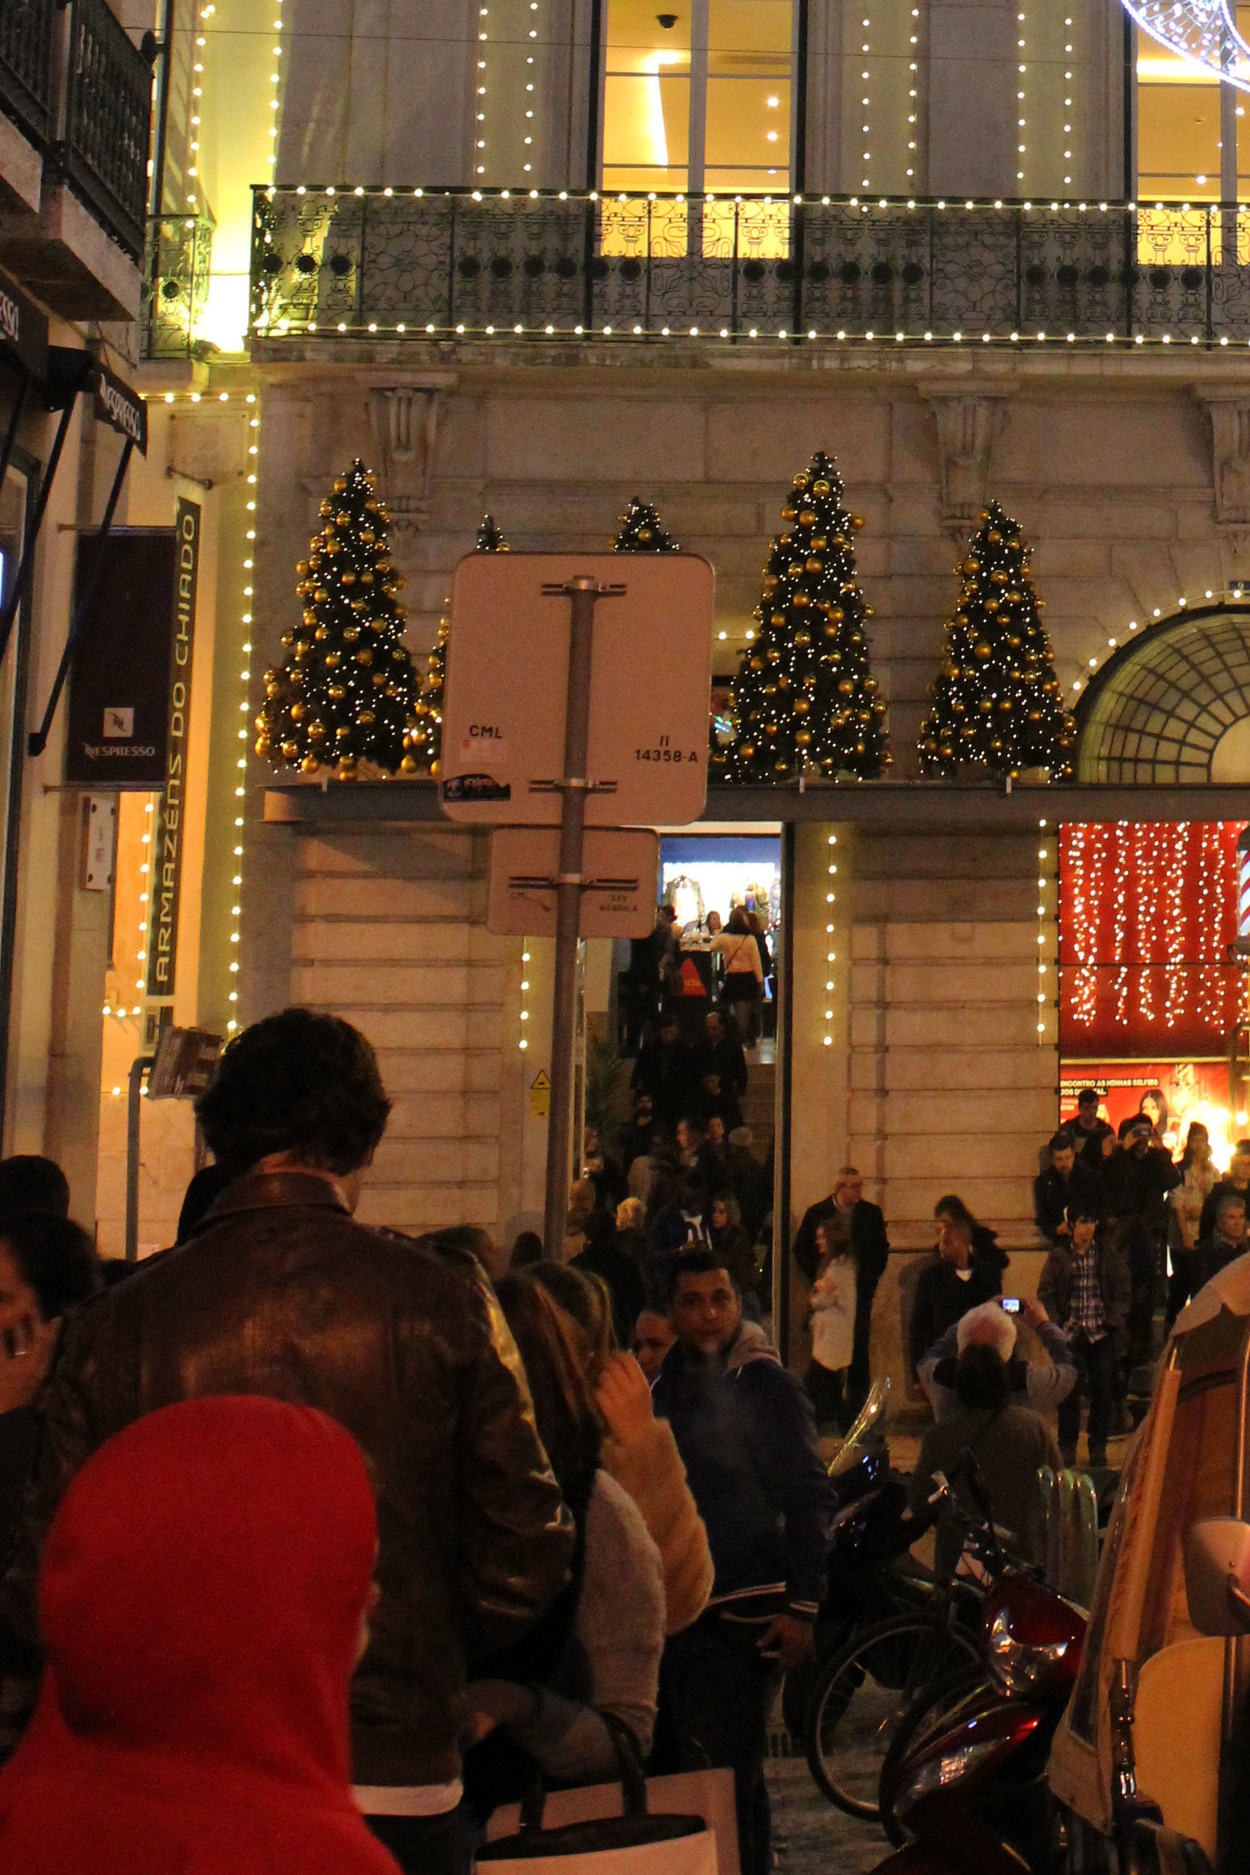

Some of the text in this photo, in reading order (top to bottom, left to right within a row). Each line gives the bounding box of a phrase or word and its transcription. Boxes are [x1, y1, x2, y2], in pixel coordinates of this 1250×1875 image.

[175, 514, 195, 666] CHIADO
[170, 681, 187, 738] DO
[469, 725, 503, 739] CML
[82, 742, 156, 760] NESPRESSO
